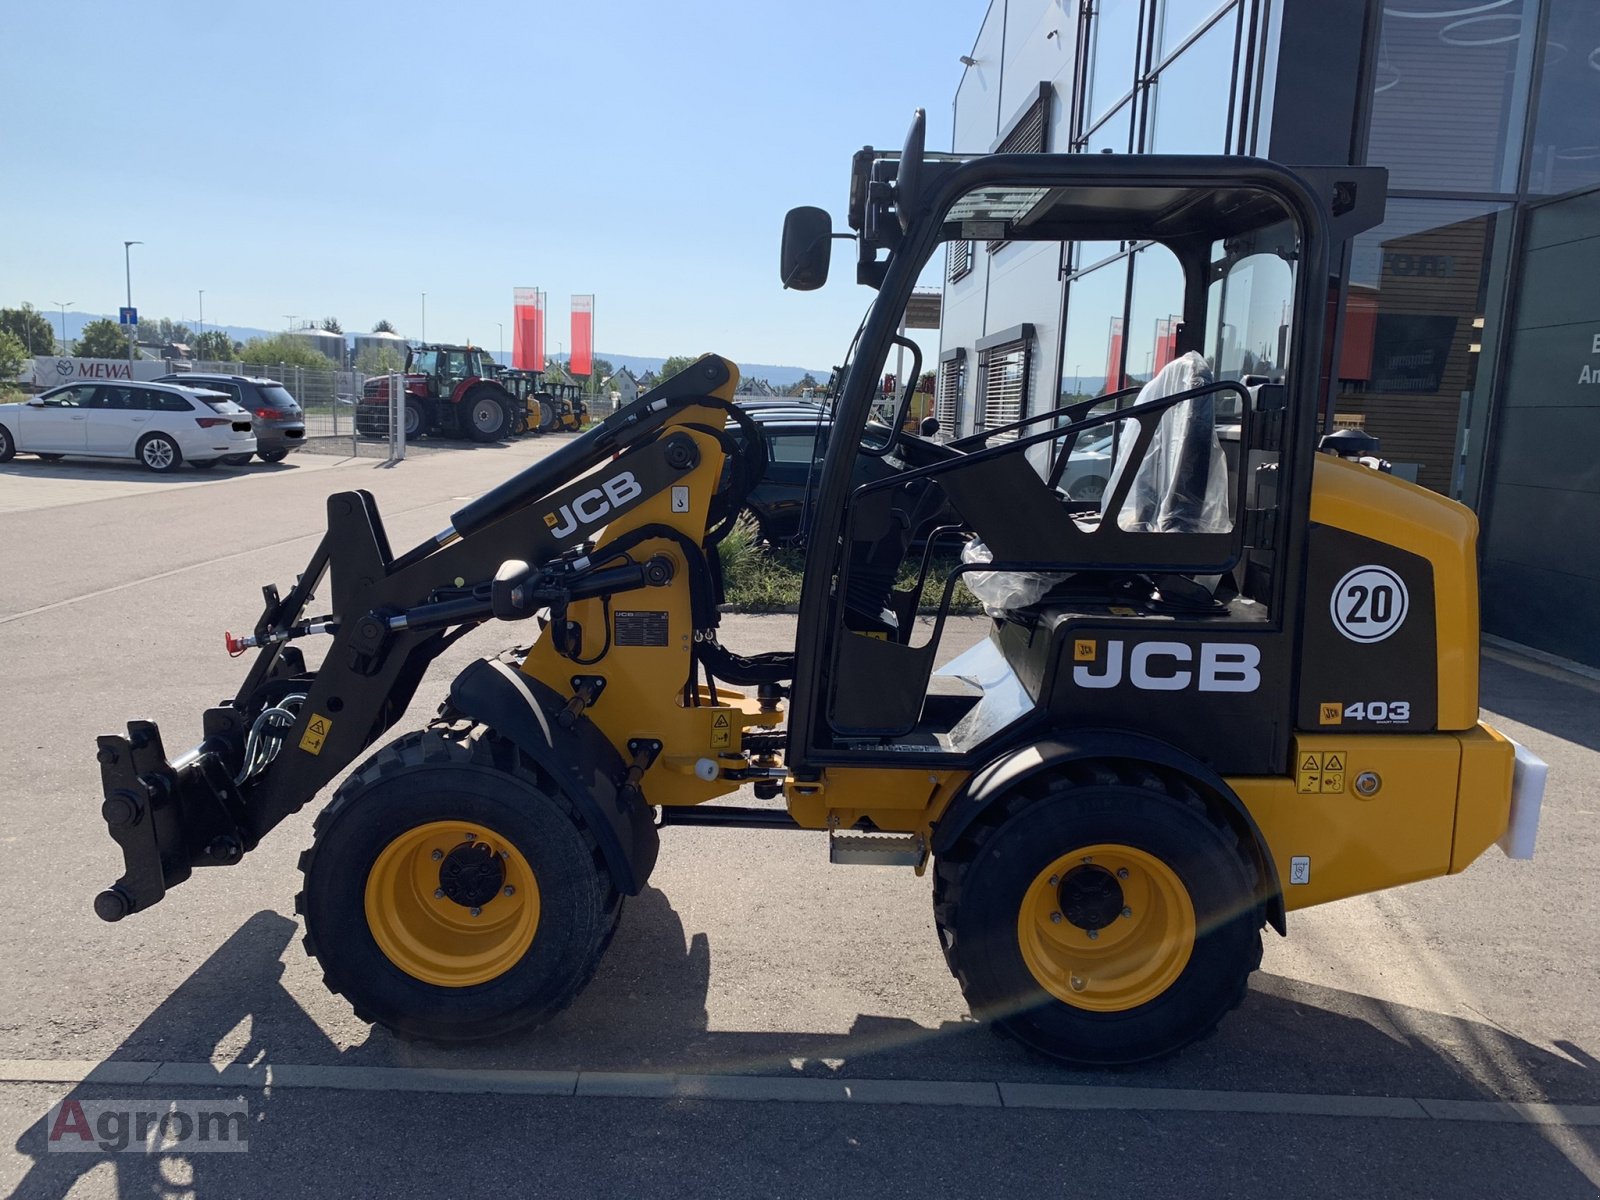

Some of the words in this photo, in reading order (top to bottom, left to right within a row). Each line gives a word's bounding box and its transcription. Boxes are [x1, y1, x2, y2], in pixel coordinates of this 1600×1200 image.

[79, 362, 131, 379] MEWA
[550, 471, 642, 539] JCB
[1346, 585, 1393, 623] 20
[1073, 640, 1261, 693] JCB
[1344, 701, 1410, 721] 403
